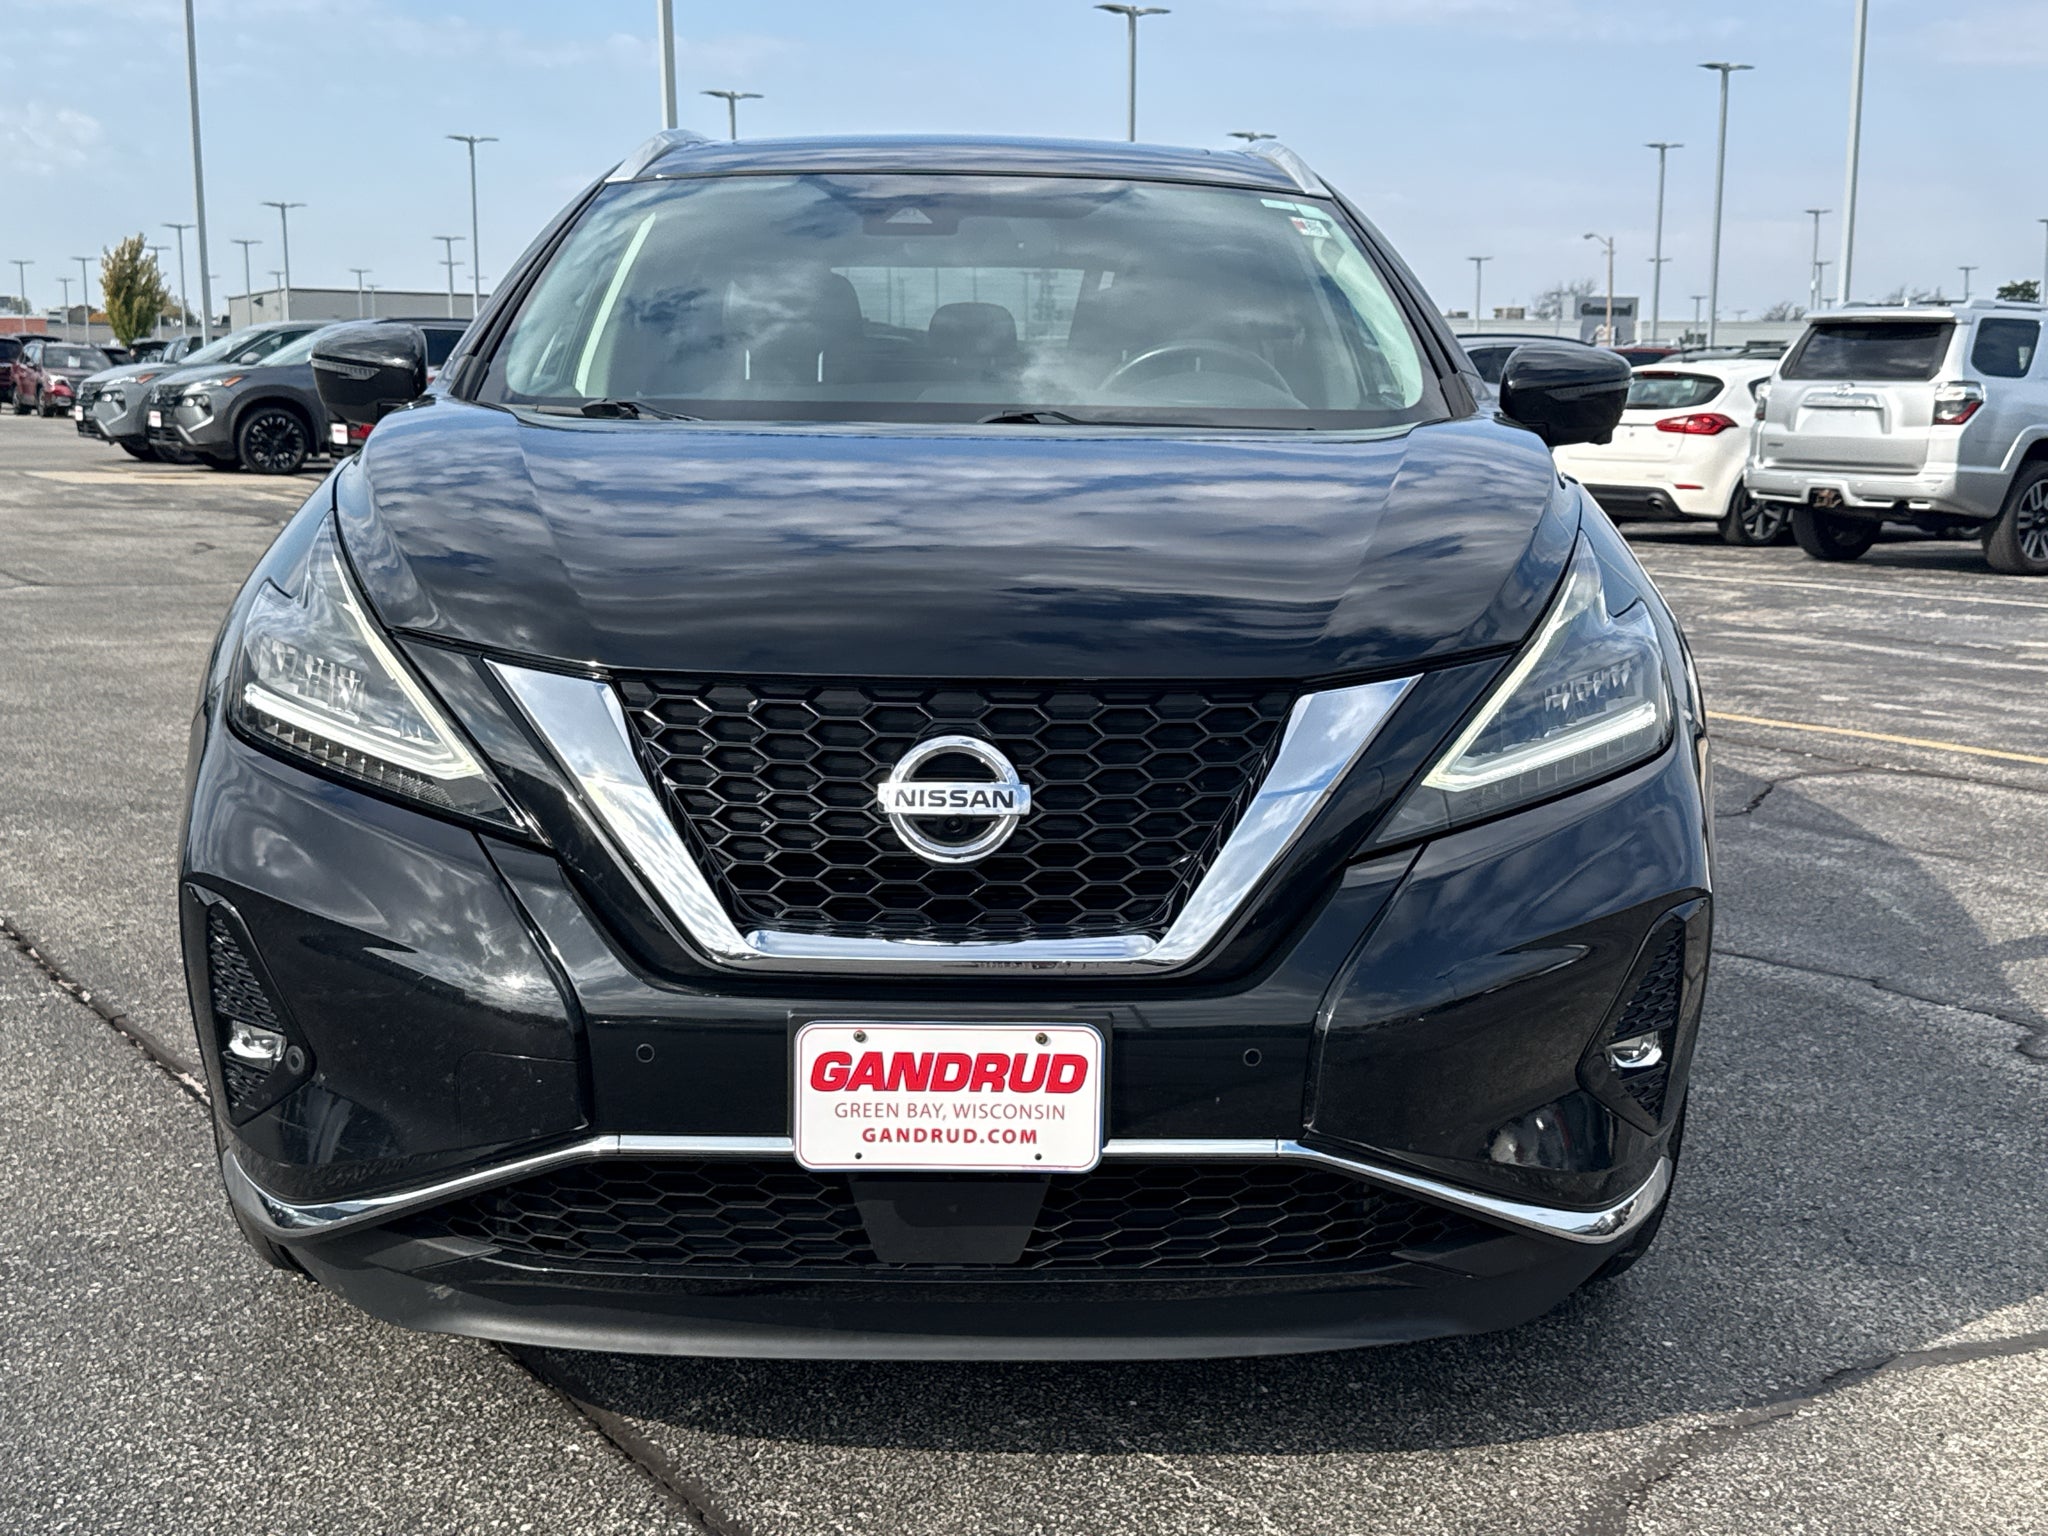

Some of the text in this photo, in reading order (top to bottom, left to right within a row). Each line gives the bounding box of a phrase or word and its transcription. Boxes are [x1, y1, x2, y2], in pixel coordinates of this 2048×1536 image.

[895, 789, 1014, 809] NISSAN
[810, 1051, 1089, 1094] GANDRUD
[834, 1102, 1066, 1121] GREEN BAY, WISCONSIN
[862, 1127, 1038, 1145] GANDRUD.COM
